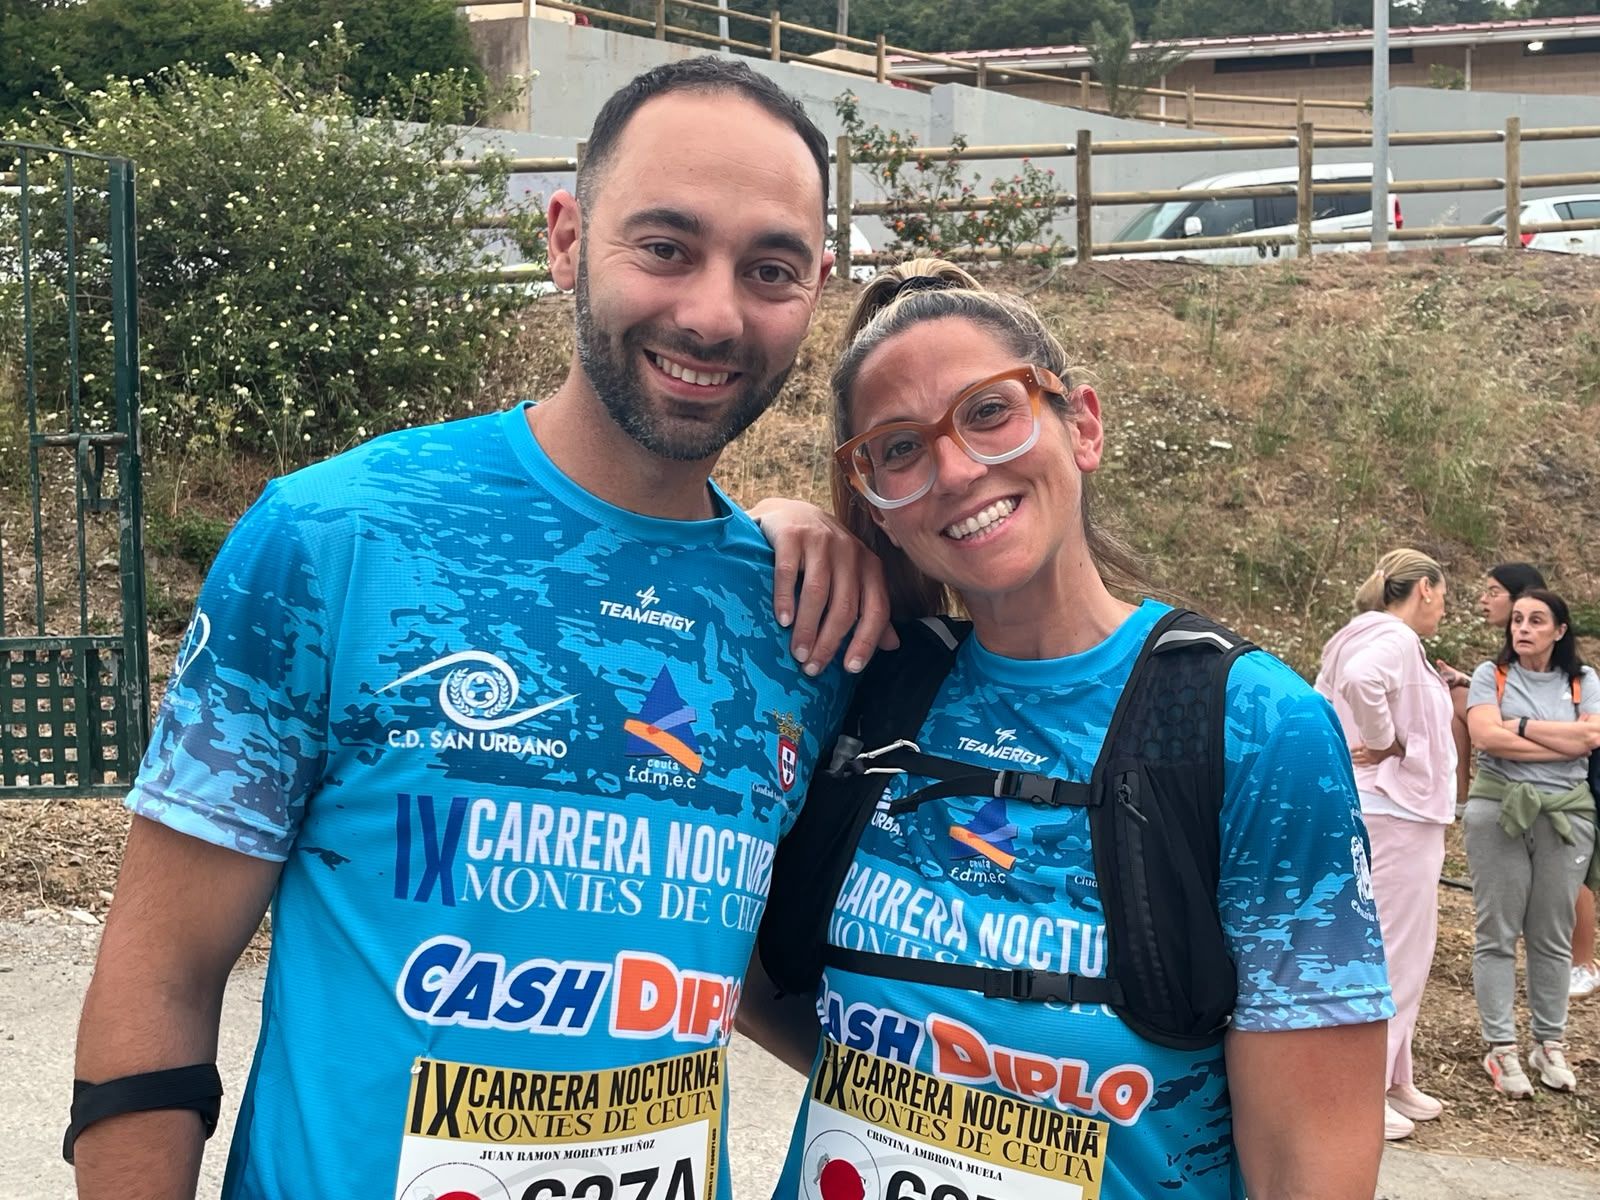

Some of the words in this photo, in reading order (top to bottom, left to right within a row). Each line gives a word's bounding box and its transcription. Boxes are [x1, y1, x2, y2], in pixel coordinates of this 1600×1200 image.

[599, 600, 696, 634] TEAMERGY
[387, 728, 425, 750] C.D.
[430, 731, 476, 752] SAN
[479, 733, 568, 760] URBANO
[646, 757, 680, 773] ceuta
[956, 735, 1050, 766] TEAMERGY
[394, 792, 470, 908] IX
[466, 797, 651, 877] CARRERA
[460, 862, 646, 917] MONTES
[658, 881, 712, 926] DE
[835, 861, 969, 952] CARRERA
[400, 939, 608, 1032] CASH
[411, 1060, 470, 1139] IX
[467, 1067, 600, 1112] CARRERA
[608, 1050, 719, 1108] NOCTURNA
[930, 1016, 1149, 1122] DIPLO
[462, 1109, 594, 1143] MONTES
[602, 1109, 638, 1135] DE
[645, 1089, 718, 1123] CEUTA
[848, 1089, 949, 1142] MONTES
[955, 1125, 993, 1156] DE
[1002, 1139, 1096, 1183] CEUTA
[851, 1053, 954, 1121] CARRERA
[961, 1089, 1100, 1159] NOCTURNA
[479, 1149, 514, 1161] JUAN
[516, 1149, 562, 1161] RAMON
[563, 1145, 618, 1160] MORENTE
[619, 1138, 656, 1155] MUÑOZ
[866, 1128, 910, 1154] CRISTINA
[912, 1147, 964, 1171] AMBRONA
[965, 1162, 1003, 1182] MUELA
